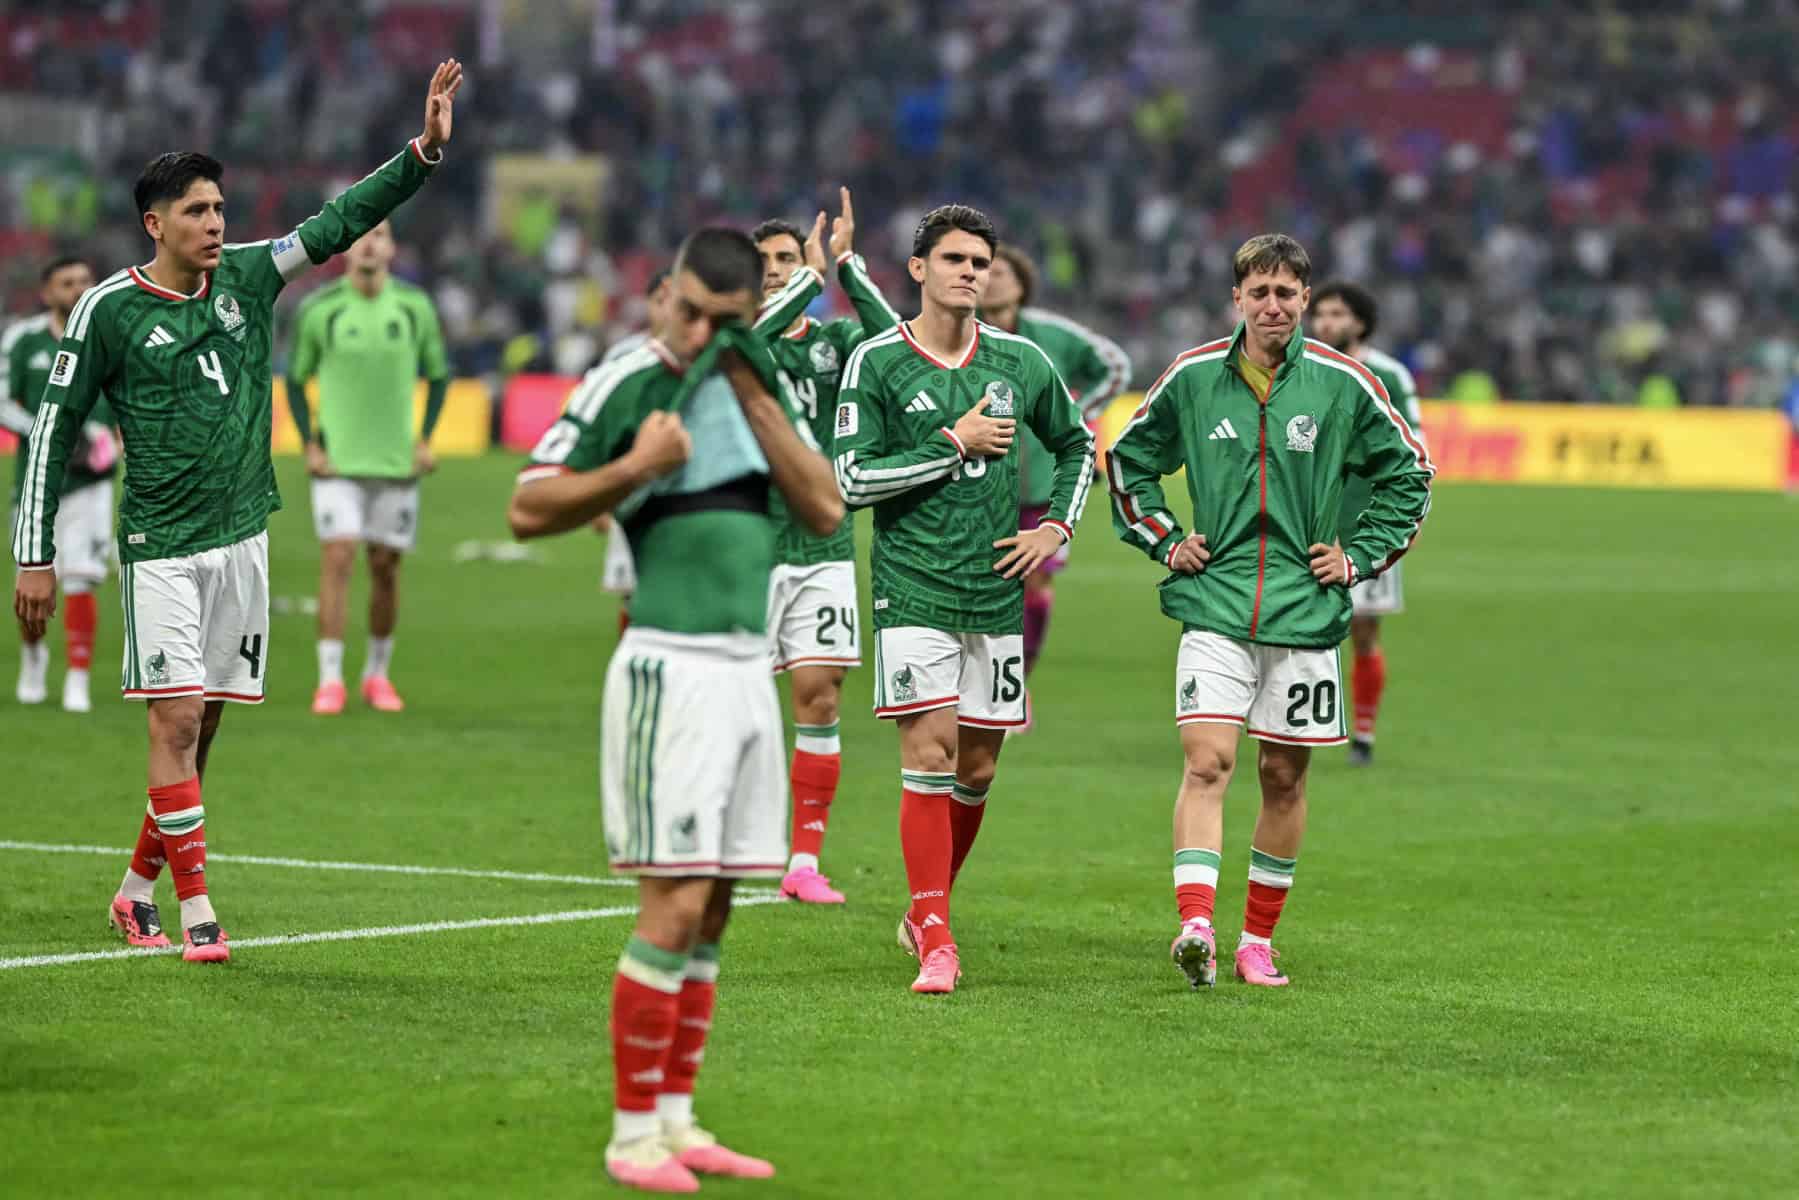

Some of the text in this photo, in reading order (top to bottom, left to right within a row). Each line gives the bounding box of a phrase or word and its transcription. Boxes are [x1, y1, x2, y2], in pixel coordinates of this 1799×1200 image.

[197, 350, 230, 395] 4
[796, 377, 818, 419] 4
[816, 606, 855, 647] 24
[239, 633, 262, 679] 4
[992, 655, 1021, 702] 15
[1286, 679, 1335, 727] 20
